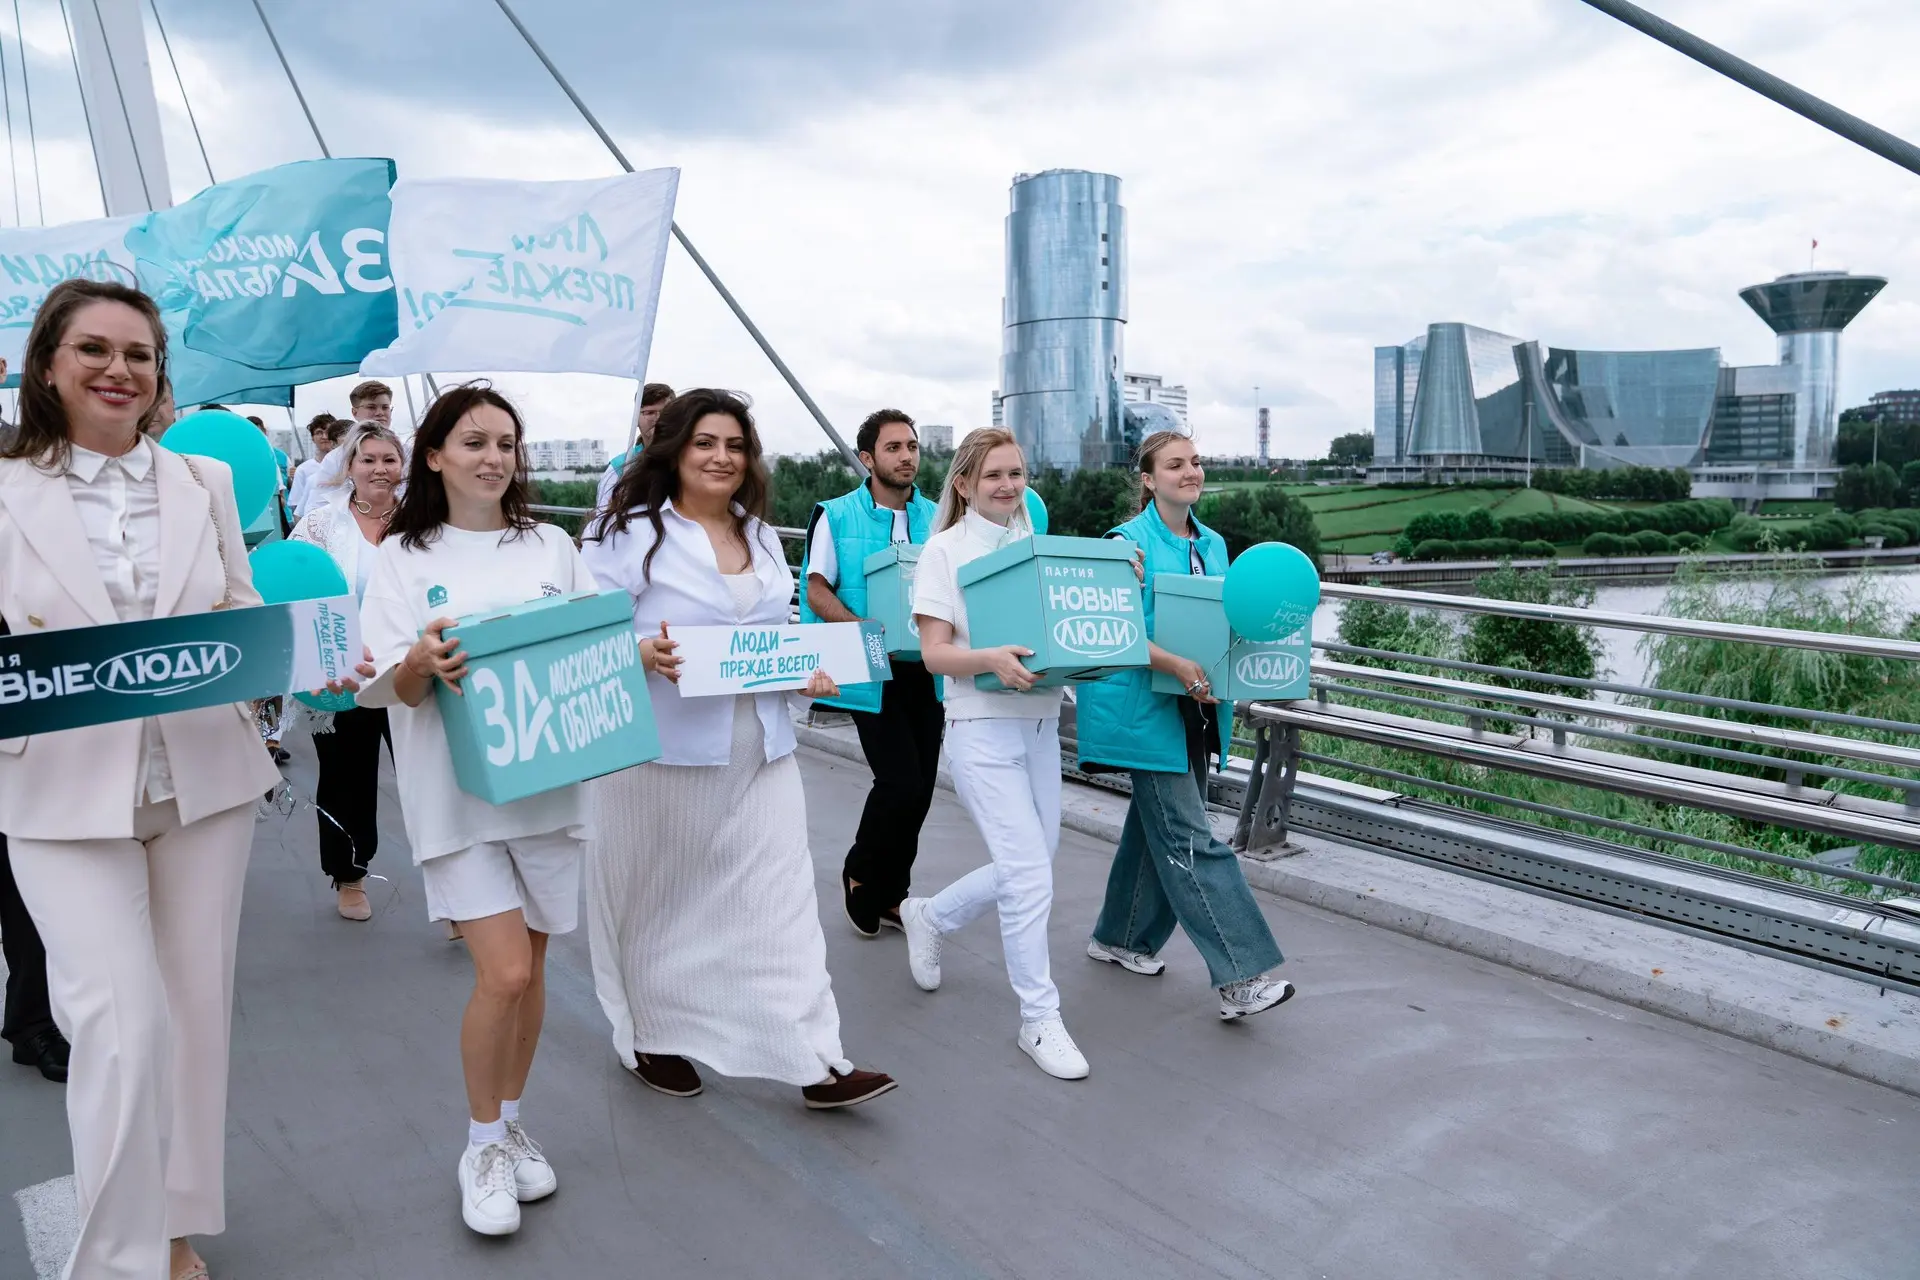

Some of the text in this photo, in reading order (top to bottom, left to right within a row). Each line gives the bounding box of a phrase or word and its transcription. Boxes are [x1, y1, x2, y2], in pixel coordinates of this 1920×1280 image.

[1045, 566, 1095, 578] ПАРТИЯ
[1049, 585, 1135, 612] НОВЫЕ
[318, 602, 337, 680] ПРЕЖДЕ ВСЕГО
[331, 612, 348, 651] ЛЮДИ
[730, 630, 779, 656] ЛЮДИ
[1060, 620, 1131, 646] ЛЮДИ
[107, 644, 228, 688] ЛЮДИ
[549, 631, 634, 699] МОСКОВСКУЮ
[720, 653, 820, 678] ПРЕЖДЕ ВСЕГО!
[1241, 656, 1298, 680] ЛЮДИ
[560, 676, 633, 752] ОБЛАСТЬ
